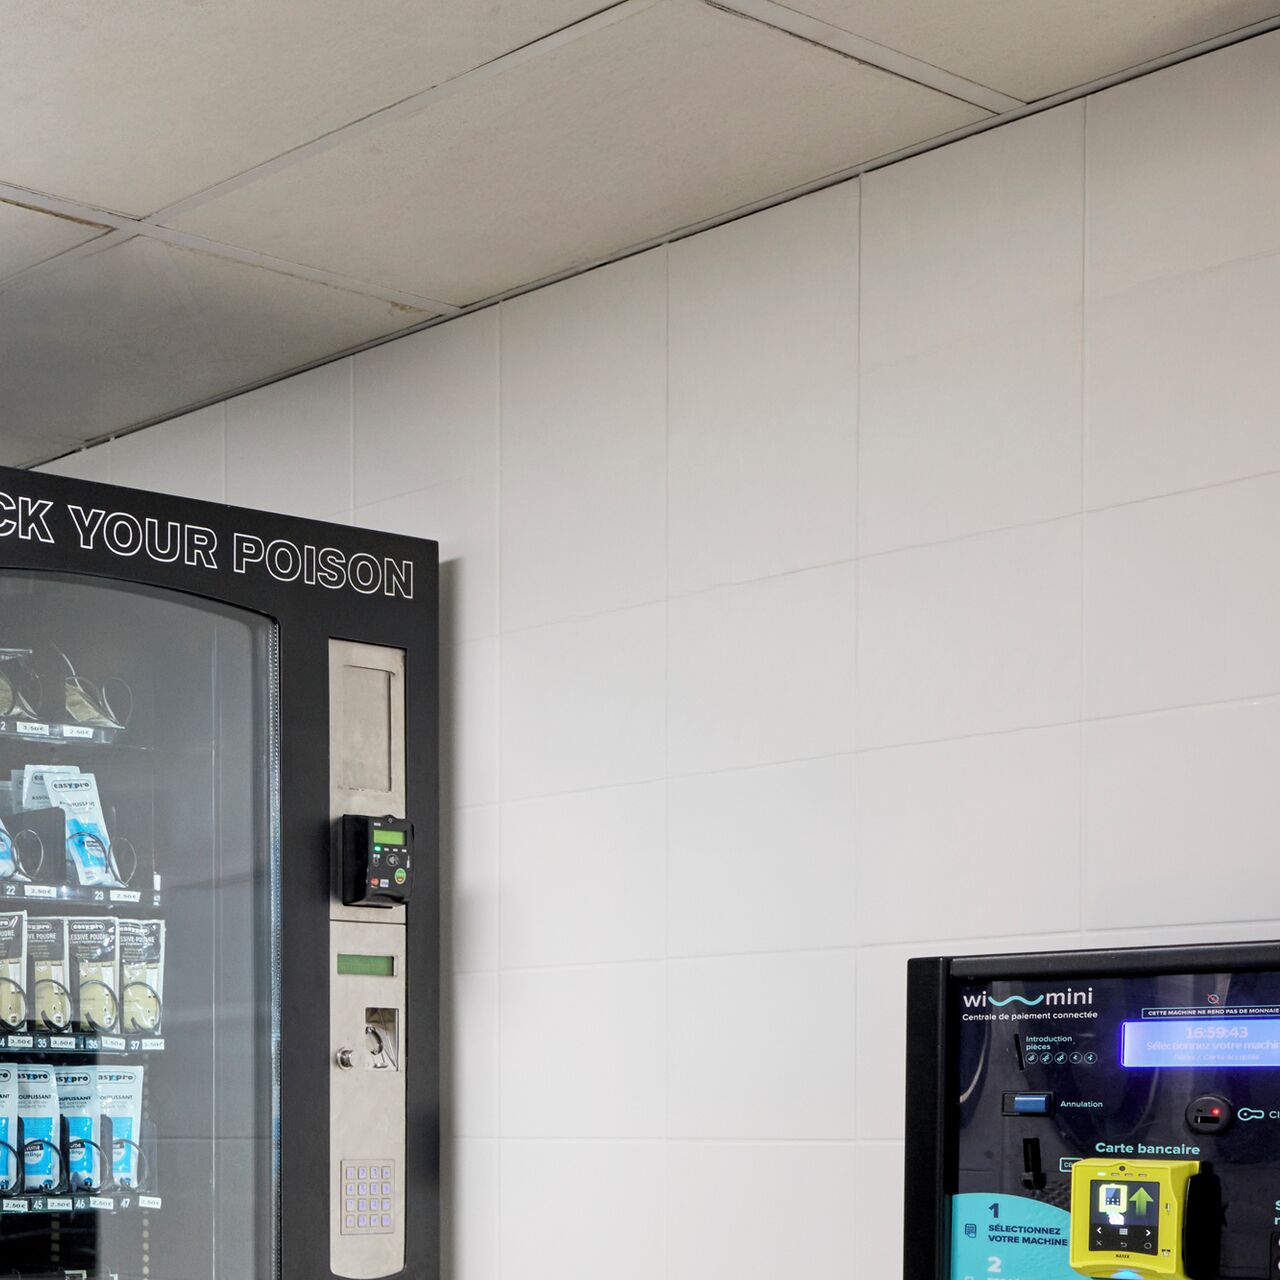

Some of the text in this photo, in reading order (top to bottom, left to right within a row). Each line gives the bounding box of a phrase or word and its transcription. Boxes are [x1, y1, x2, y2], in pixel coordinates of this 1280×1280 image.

[67, 504, 217, 569] YOUR
[233, 533, 413, 599] POISON
[6, 886, 16, 895] 22
[1045, 987, 1094, 1006] mini
[962, 1013, 997, 1021] Centrale
[1011, 1011, 1051, 1022] paiement
[1052, 1010, 1098, 1019] connectée
[1026, 1035, 1073, 1043] Introduction
[1186, 1026, 1249, 1040] 16:59:43
[130, 1040, 140, 1050] 37
[1060, 1100, 1103, 1108] Annulation
[1095, 1142, 1200, 1156] Carte bancaire
[988, 1203, 999, 1218] 1
[988, 1223, 1061, 1235] SÉLECTIONNEZ
[988, 1235, 1068, 1246] VOTRE MACHINE
[987, 1257, 1002, 1273] 2
